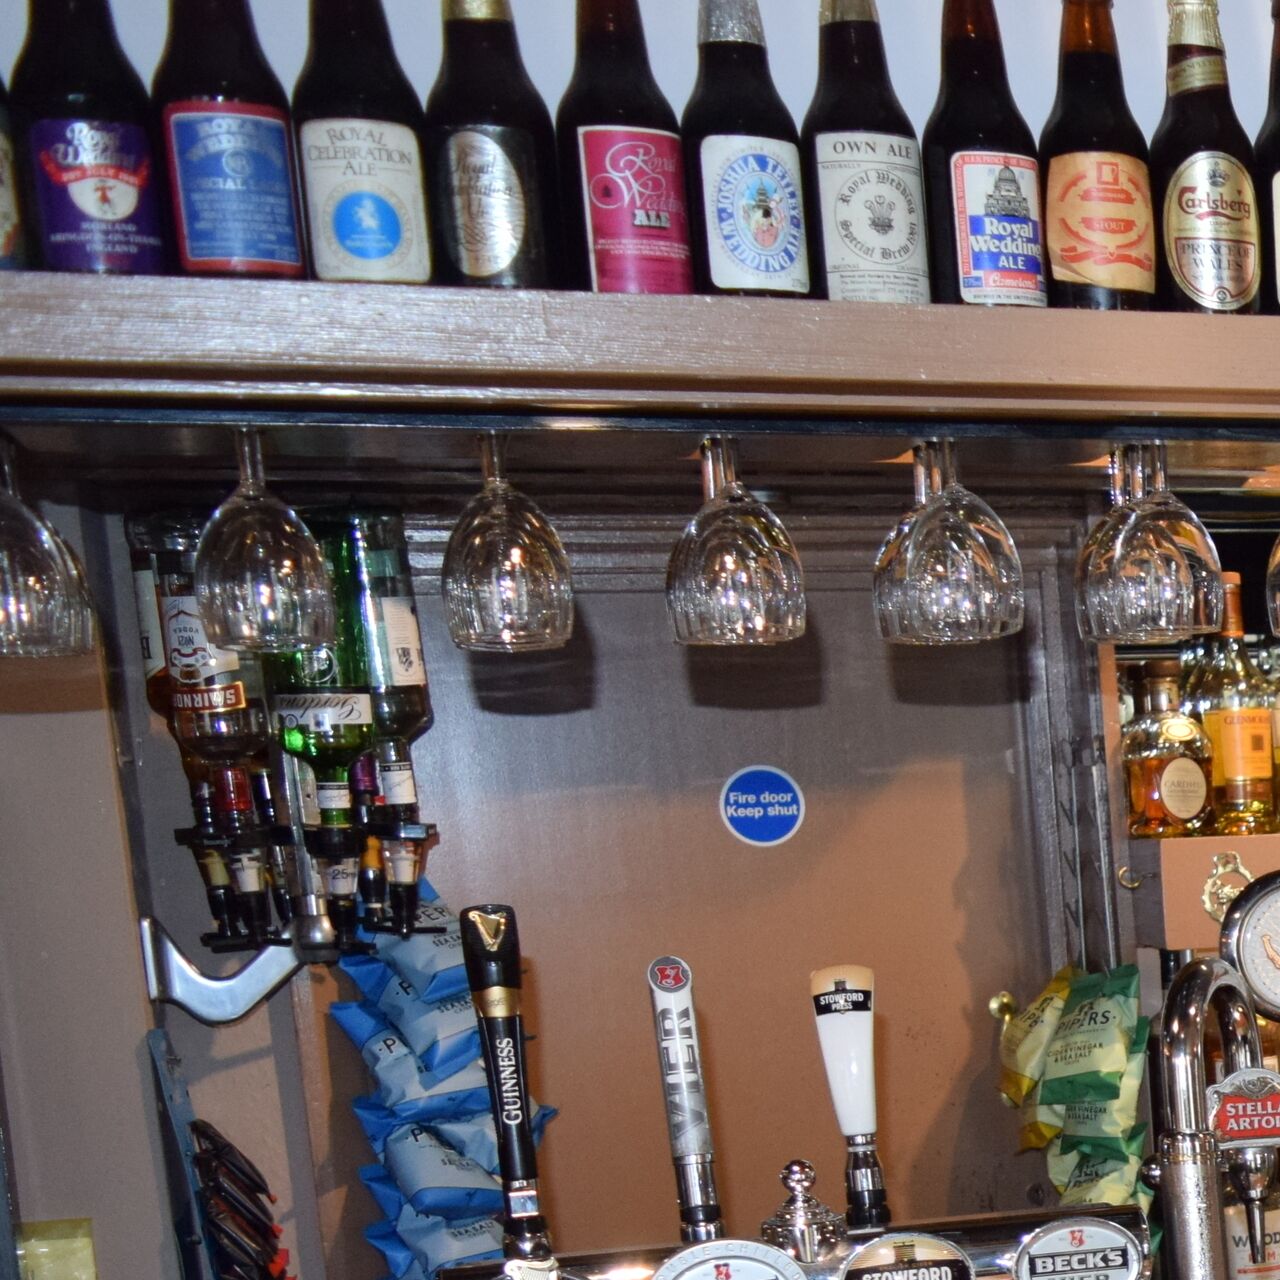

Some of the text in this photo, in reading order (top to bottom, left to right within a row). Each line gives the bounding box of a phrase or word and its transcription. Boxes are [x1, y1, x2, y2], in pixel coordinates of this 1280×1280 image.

[326, 126, 388, 147] ROYAL
[308, 144, 413, 166] CELEBRATION
[604, 140, 677, 176] Royal
[832, 141, 913, 160] OWN ALE
[342, 162, 377, 177] ALE
[717, 158, 760, 216] JOSHUA
[840, 169, 917, 216] Royal Wedding
[1177, 185, 1252, 220] Carlsberg
[632, 209, 671, 228] ALE
[984, 218, 1034, 242] Royal
[720, 220, 790, 274] WEDDING
[839, 218, 911, 260] Special Brew
[970, 235, 1042, 261] Wedding
[998, 254, 1027, 271] ALE
[729, 790, 793, 805] Fire door
[726, 803, 799, 820] Keep shut
[819, 991, 864, 1006] STOWFORD
[831, 1001, 853, 1011] PRESS
[498, 1037, 524, 1126] GUINNESS
[657, 1006, 708, 1139] VIER
[1034, 1246, 1124, 1276] BECK'S
